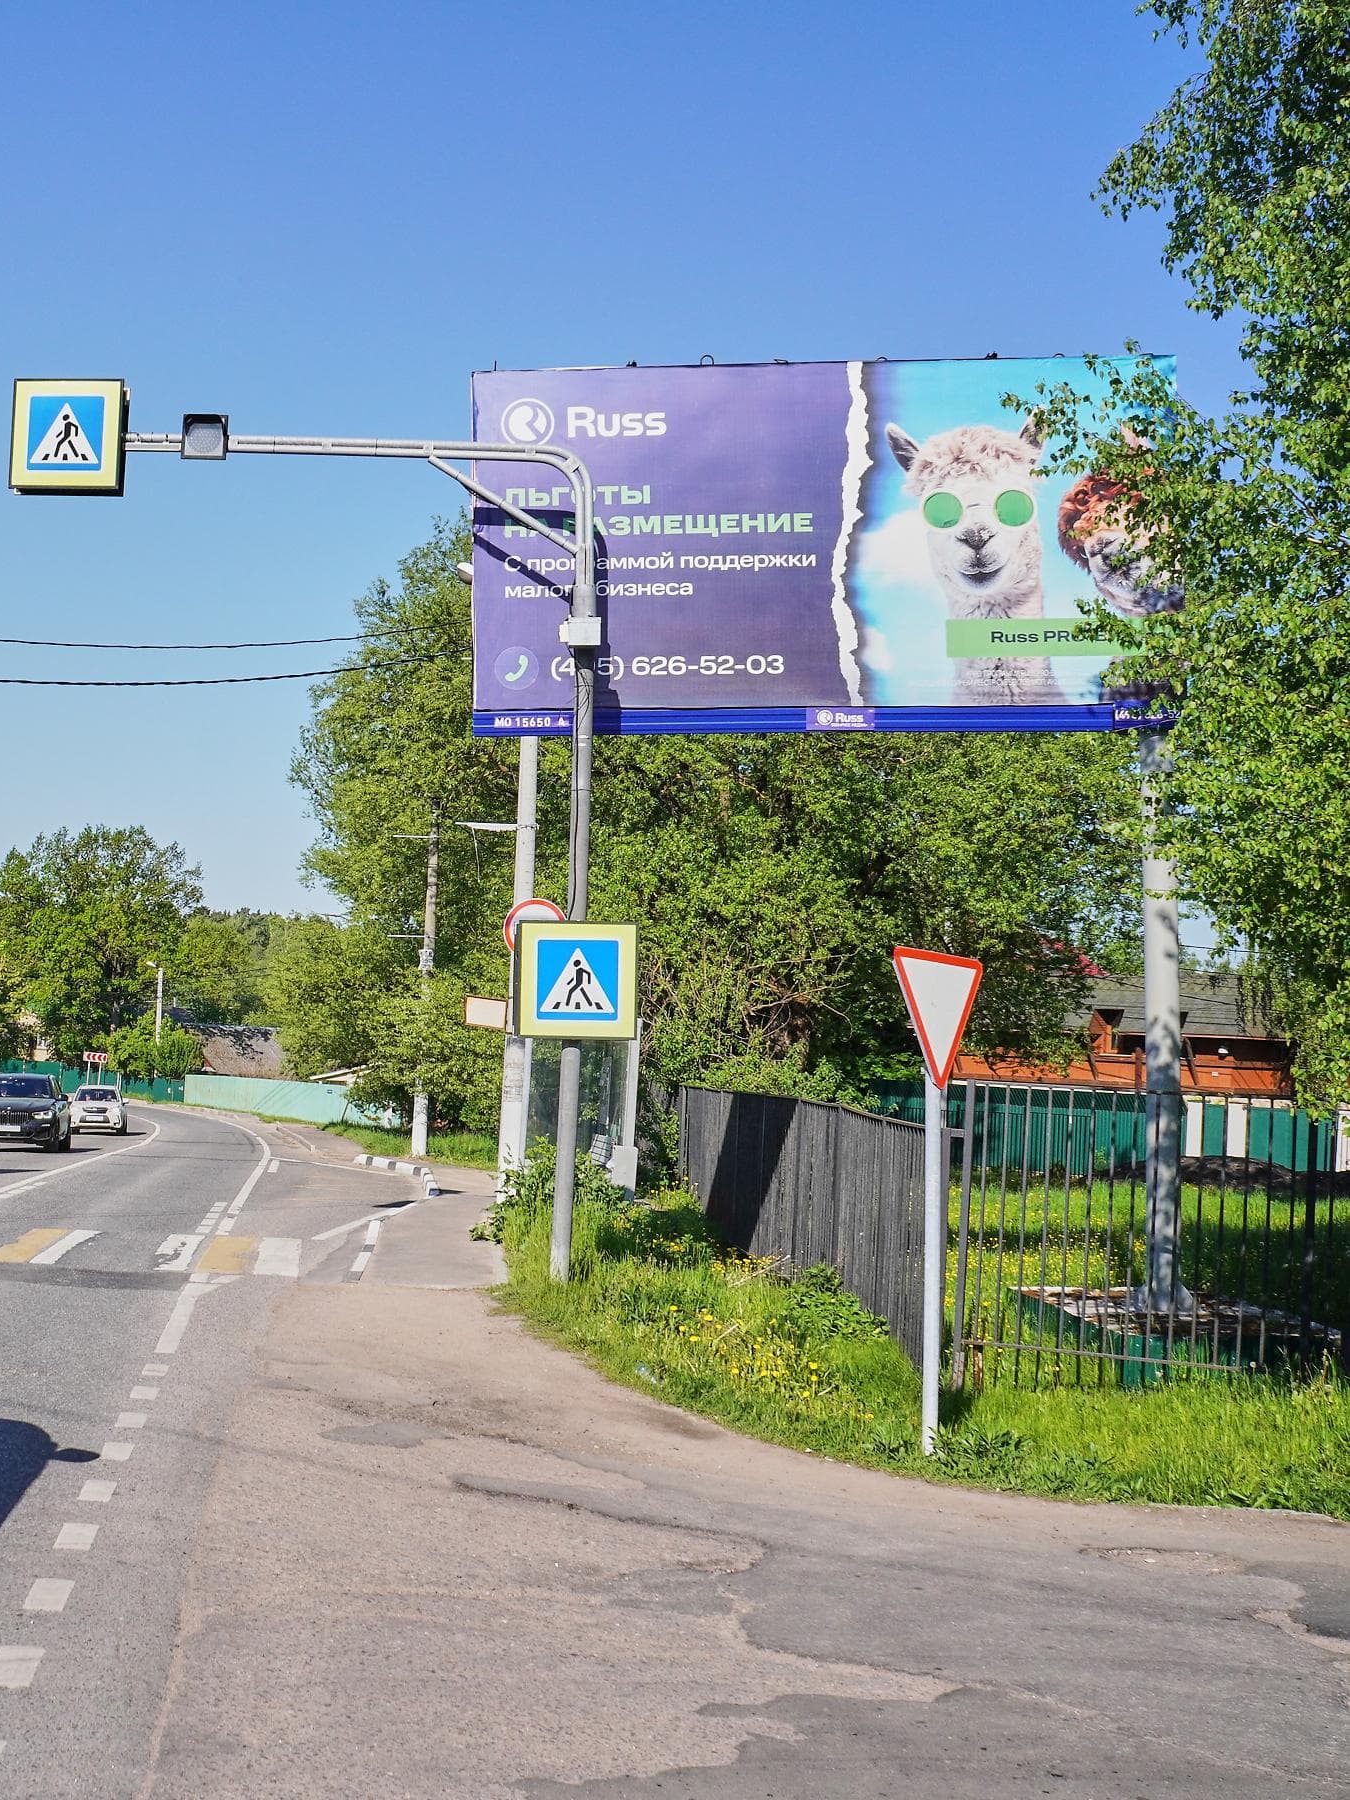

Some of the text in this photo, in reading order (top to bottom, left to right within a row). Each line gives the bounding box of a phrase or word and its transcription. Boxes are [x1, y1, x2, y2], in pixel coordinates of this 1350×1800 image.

[567, 406, 667, 438] Russ
[505, 556, 521, 572] С
[680, 554, 816, 571] поддержки
[596, 580, 693, 597] бизнеса
[990, 631, 1039, 643] Russ
[551, 654, 785, 681] (45) 626-52-03
[515, 717, 551, 727] 15650
[835, 713, 864, 723] Russ
